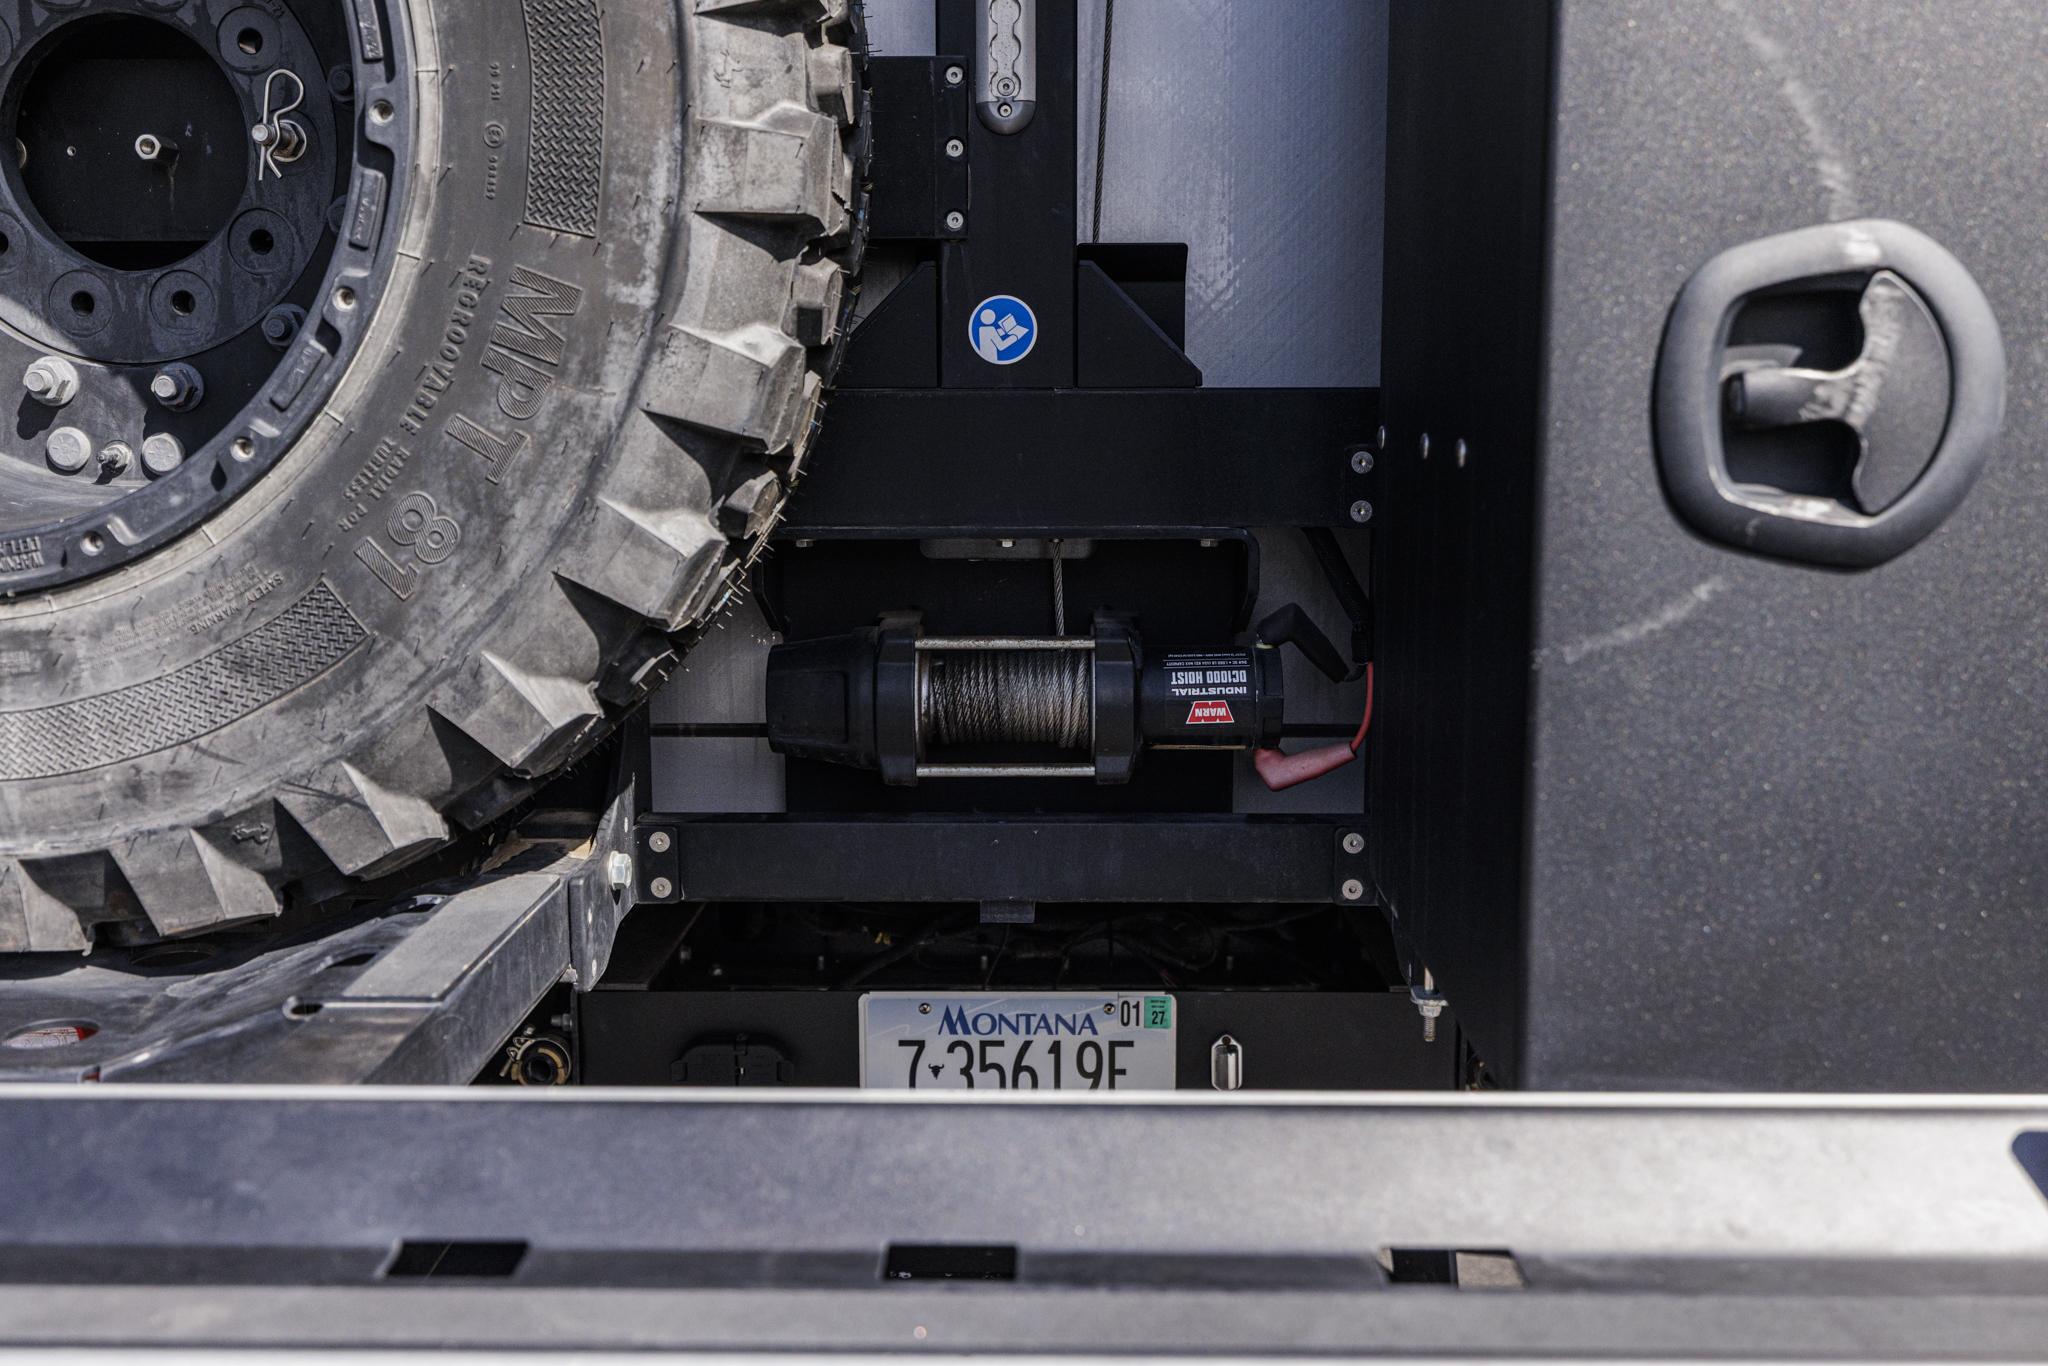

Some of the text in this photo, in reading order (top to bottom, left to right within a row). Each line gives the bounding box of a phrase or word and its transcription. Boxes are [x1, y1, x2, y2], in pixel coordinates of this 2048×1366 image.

[402, 254, 491, 436] REGROOVABLE
[353, 264, 583, 602] MPT 81
[343, 437, 396, 500] TUBELESS
[367, 446, 411, 501] RADIAL
[245, 573, 284, 605] SAFETY
[1171, 670, 1247, 685] DC1000 HOIST
[1172, 687, 1247, 696] INDUSTRIAL
[1195, 707, 1227, 717] WARN
[1120, 1000, 1140, 1027] 01
[1151, 1010, 1166, 1025] 27
